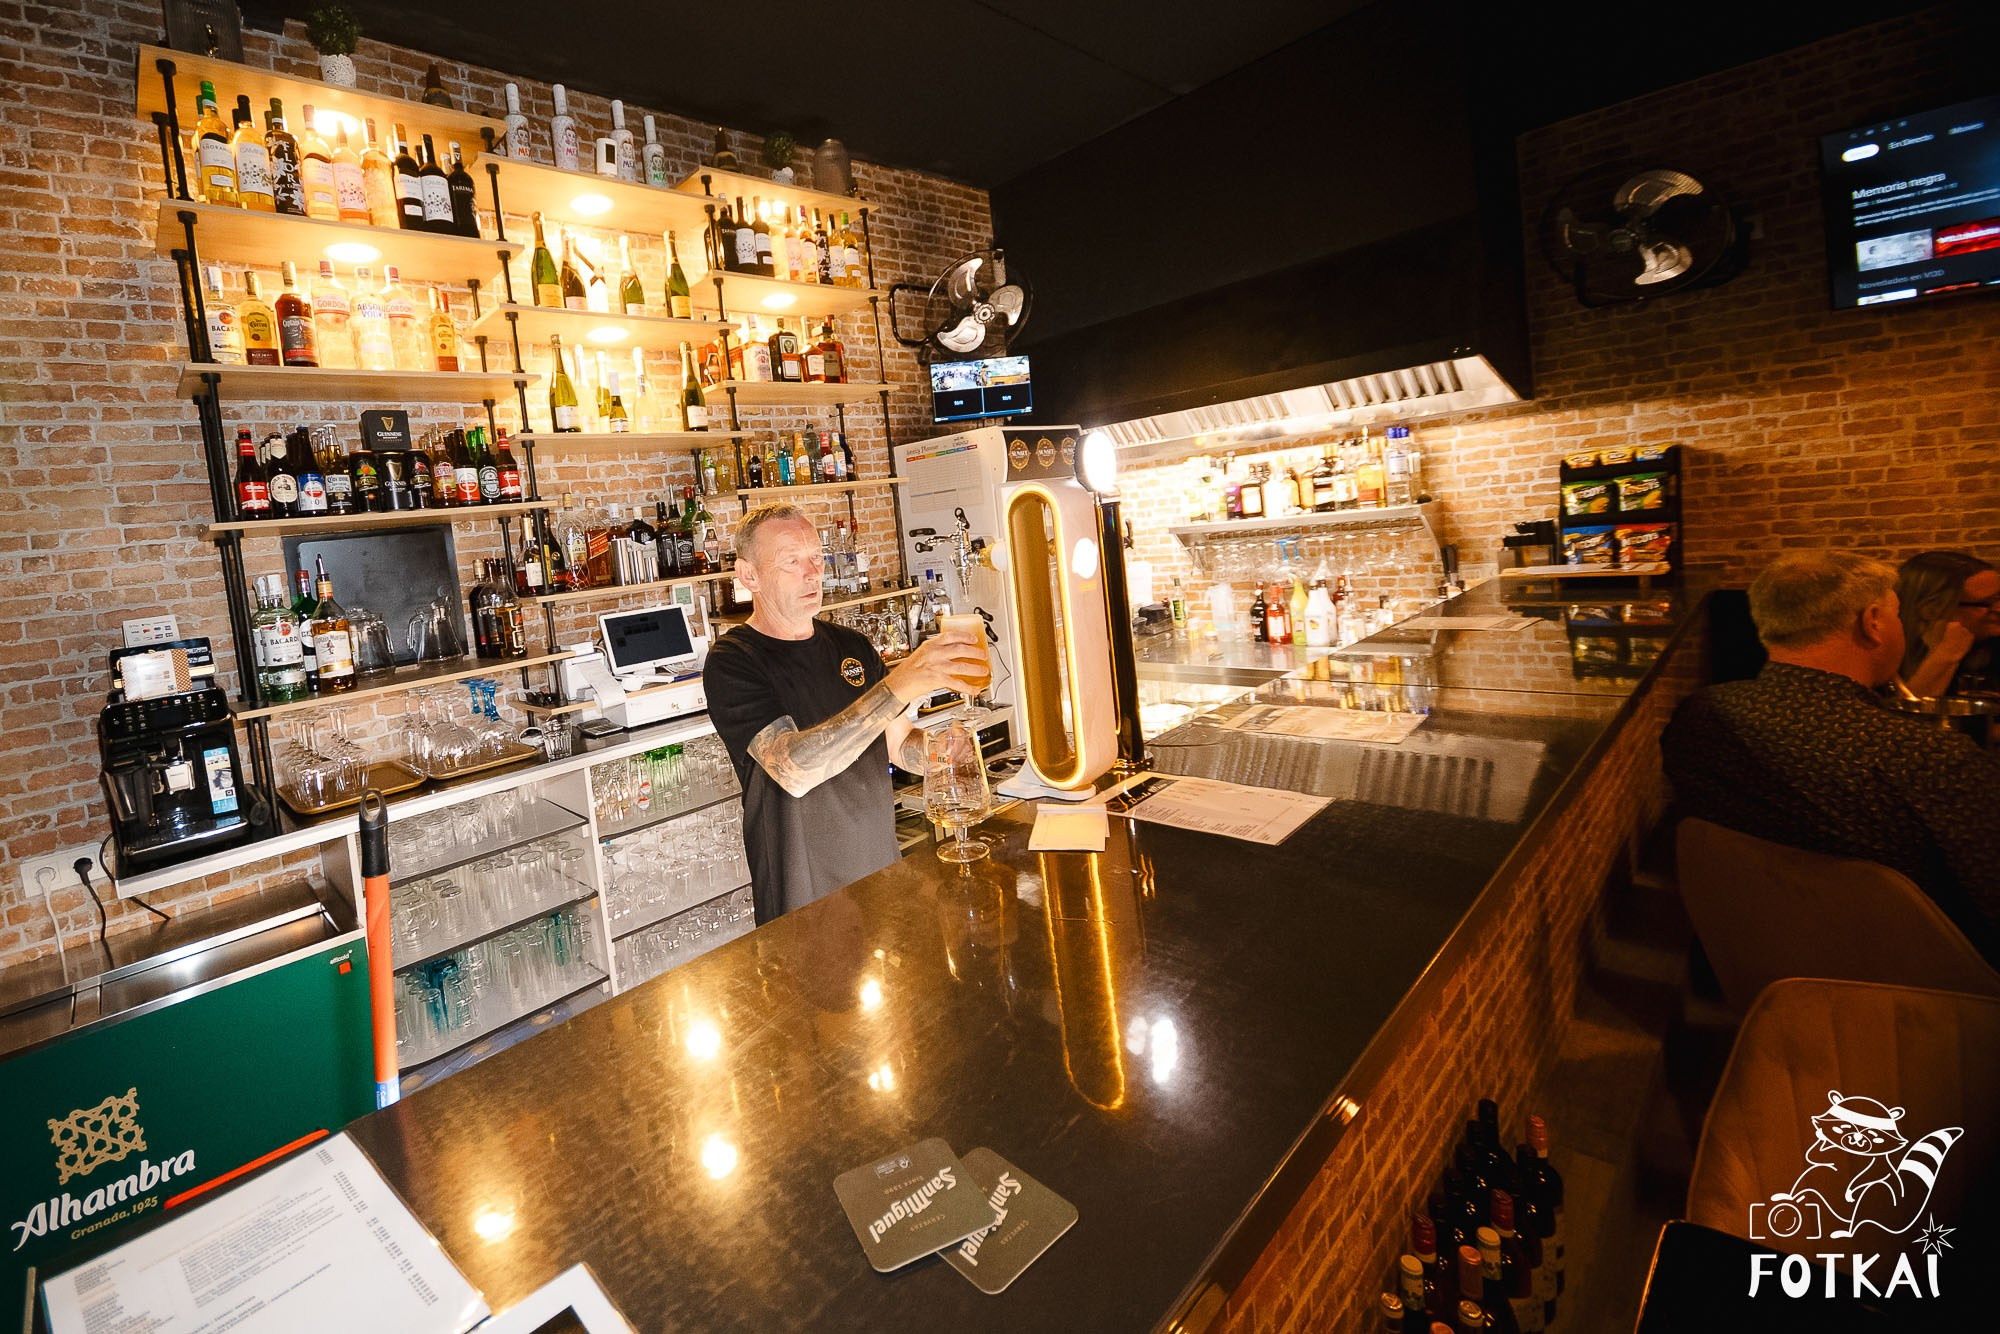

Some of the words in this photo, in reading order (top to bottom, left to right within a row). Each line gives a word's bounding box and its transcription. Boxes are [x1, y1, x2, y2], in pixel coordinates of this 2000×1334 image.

[281, 142, 296, 184] FLOR
[1852, 181, 1907, 199] Memoria
[1908, 173, 1946, 188] negra
[11, 1149, 196, 1252] Alhambra
[71, 1209, 131, 1240] Granada,
[132, 1196, 159, 1215] 1925
